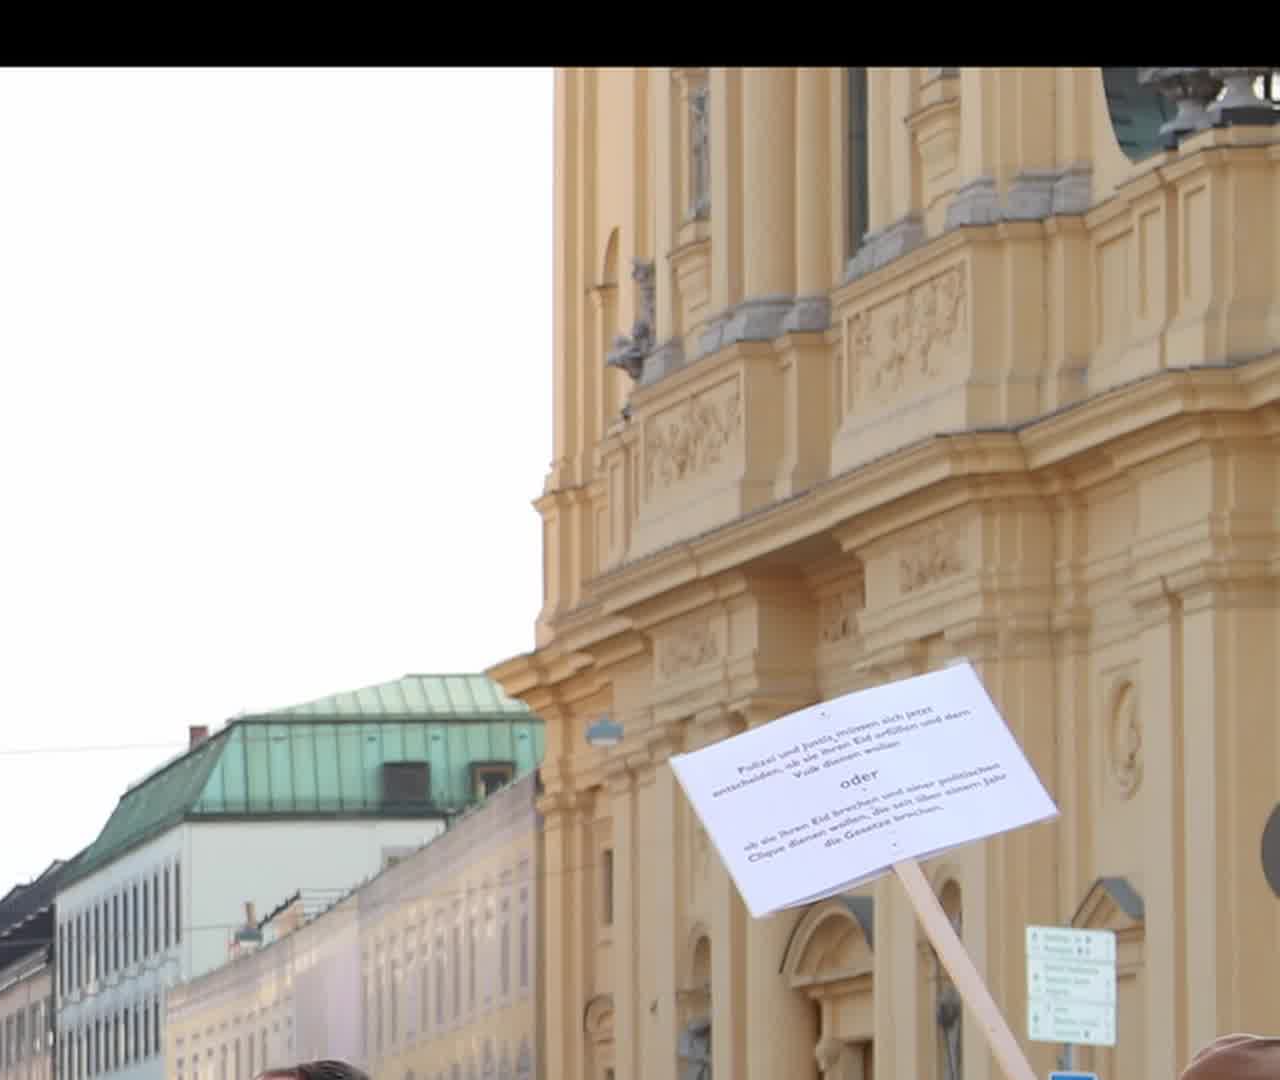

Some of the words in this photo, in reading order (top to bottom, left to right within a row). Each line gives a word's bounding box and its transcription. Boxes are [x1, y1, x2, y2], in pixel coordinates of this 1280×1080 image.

[853, 734, 872, 744] Eid
[920, 716, 942, 726] und
[778, 746, 800, 759] und
[840, 770, 878, 789] oder
[811, 813, 831, 825] Eid
[881, 788, 904, 800] und
